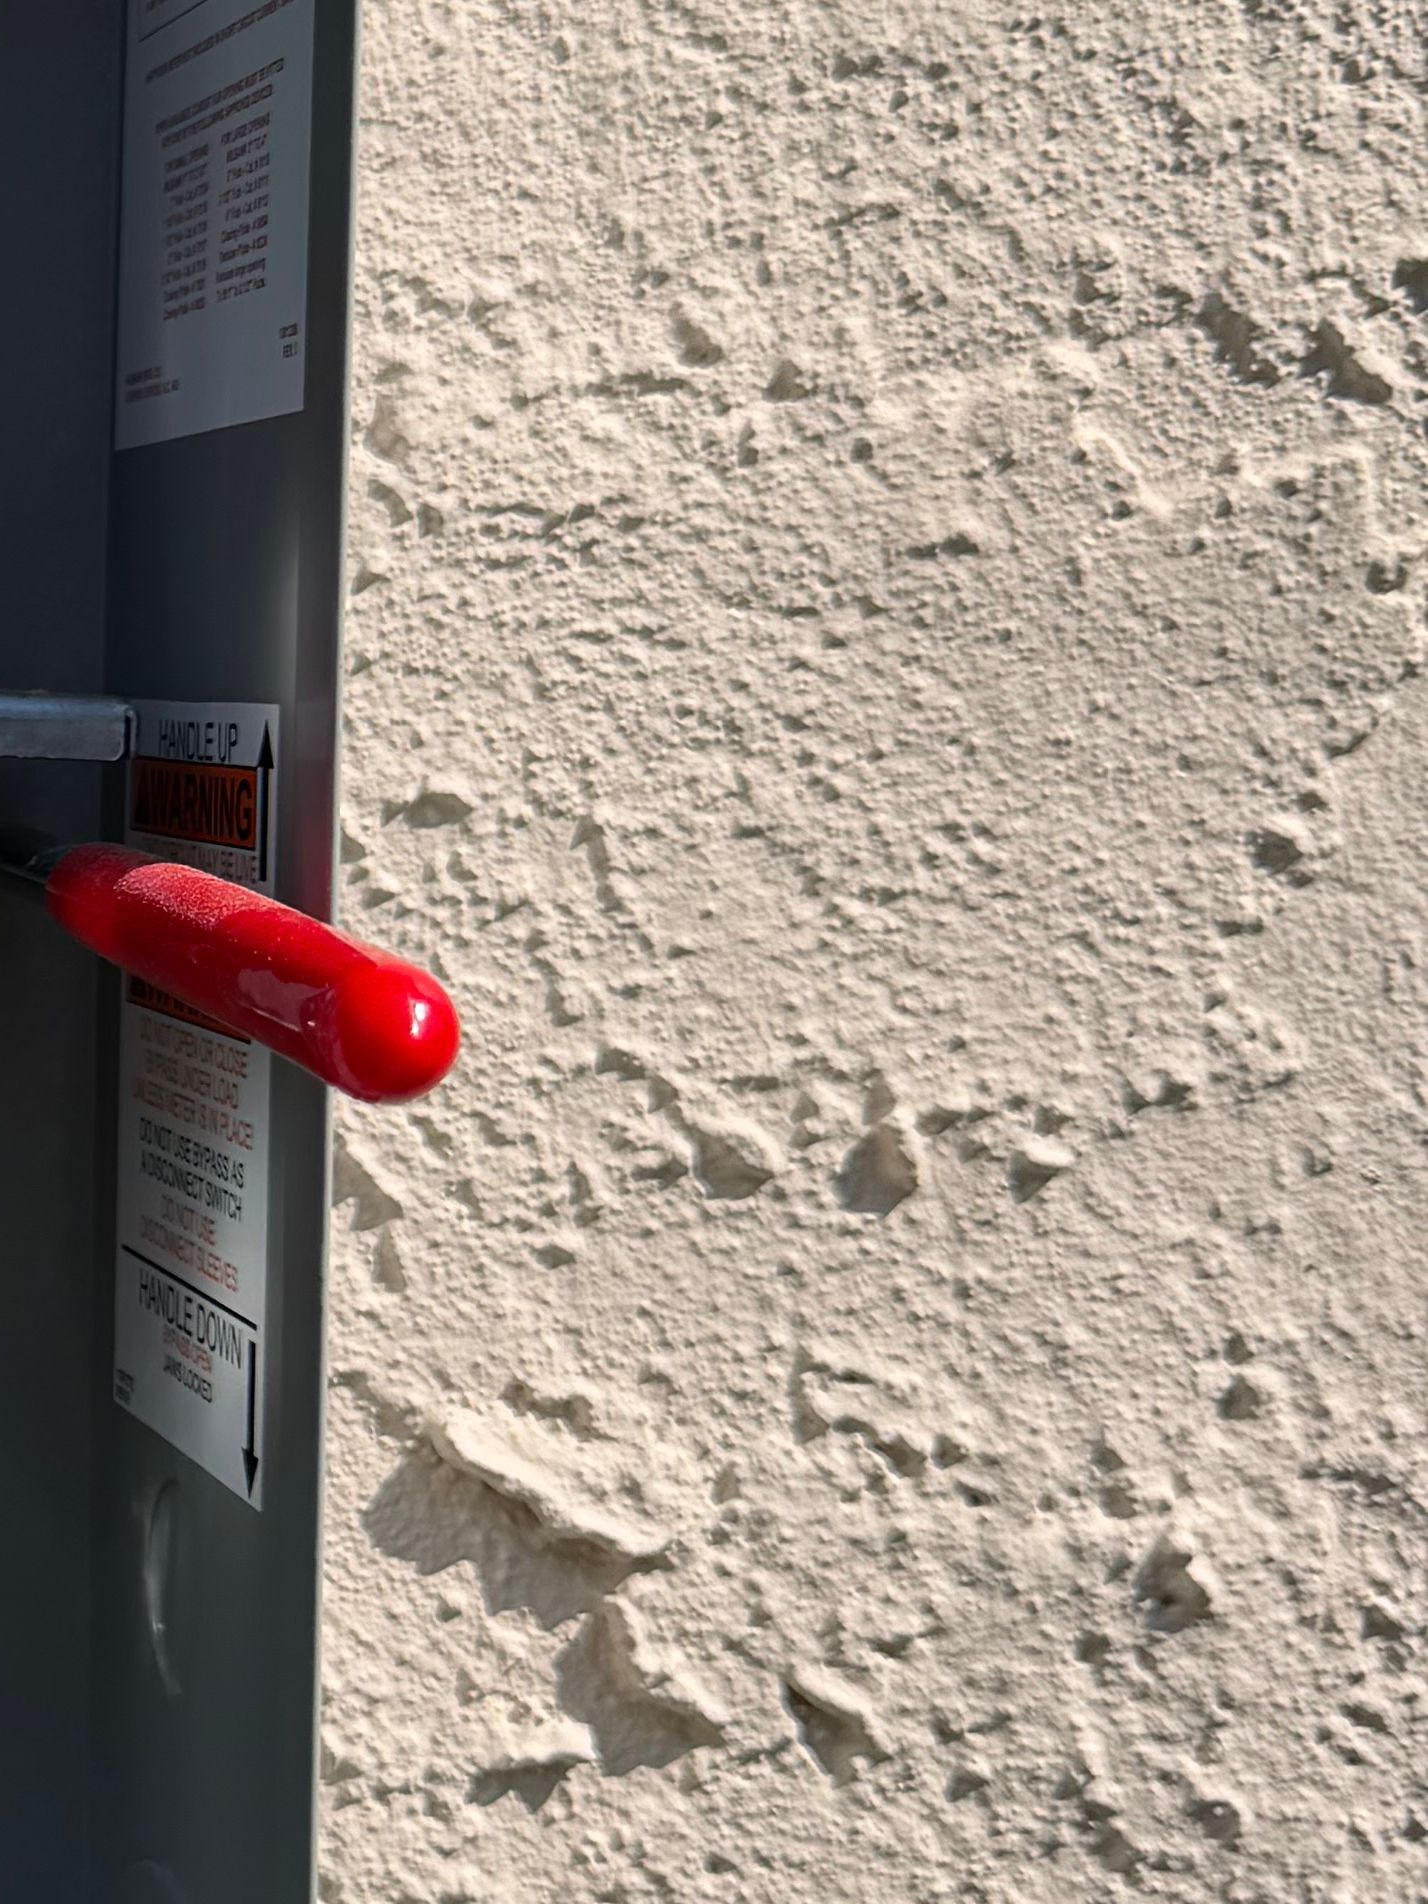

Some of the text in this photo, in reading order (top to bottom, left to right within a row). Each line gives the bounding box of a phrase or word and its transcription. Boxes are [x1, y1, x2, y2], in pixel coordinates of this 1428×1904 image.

[157, 718, 237, 764] HANDLE UP
[147, 766, 252, 841] WARNING
[174, 1134, 191, 1165] USE
[193, 1141, 229, 1182] BYPASS
[232, 1162, 244, 1188] AS
[206, 1181, 242, 1223] SWITCH
[138, 1267, 242, 1370] HANDLE DOWN
